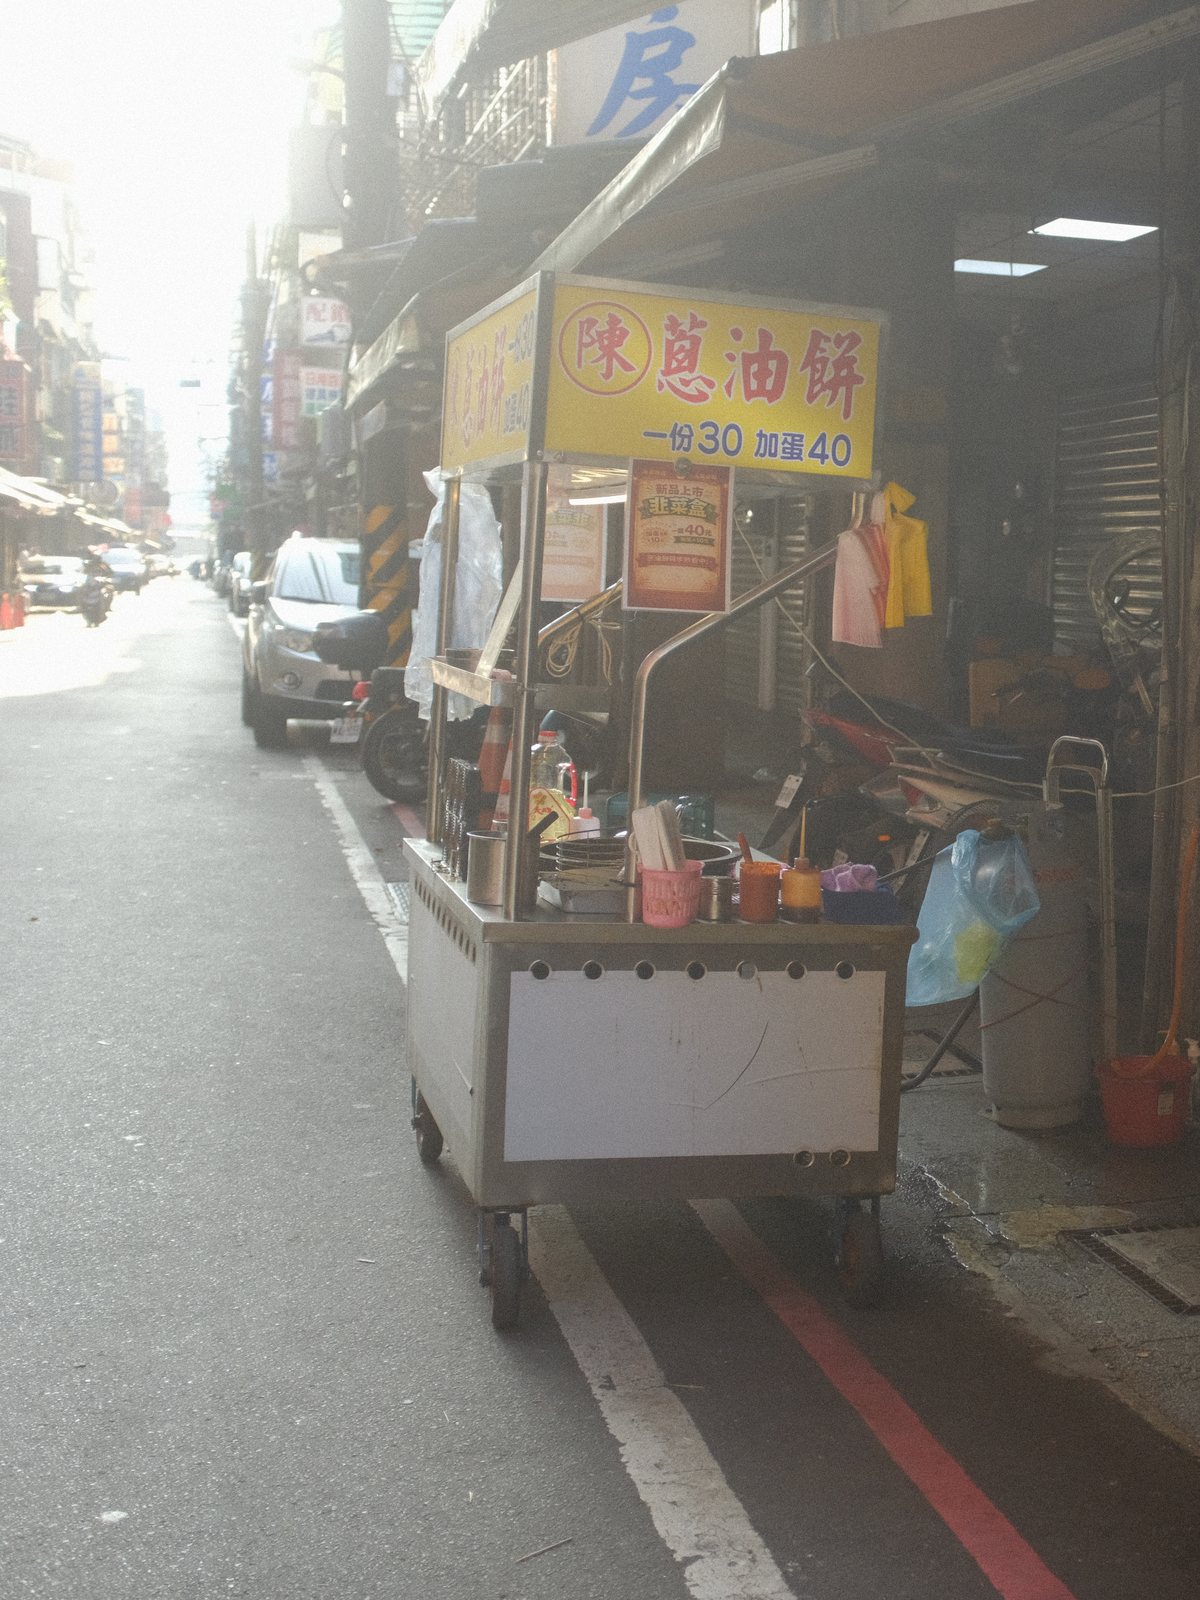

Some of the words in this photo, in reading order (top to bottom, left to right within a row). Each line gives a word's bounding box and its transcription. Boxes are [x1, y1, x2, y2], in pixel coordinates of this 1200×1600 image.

[642, 420, 744, 457] 一份30
[754, 430, 852, 468] 加蛋40
[656, 484, 705, 497] 新品上市
[648, 496, 706, 518] 韭菜盒
